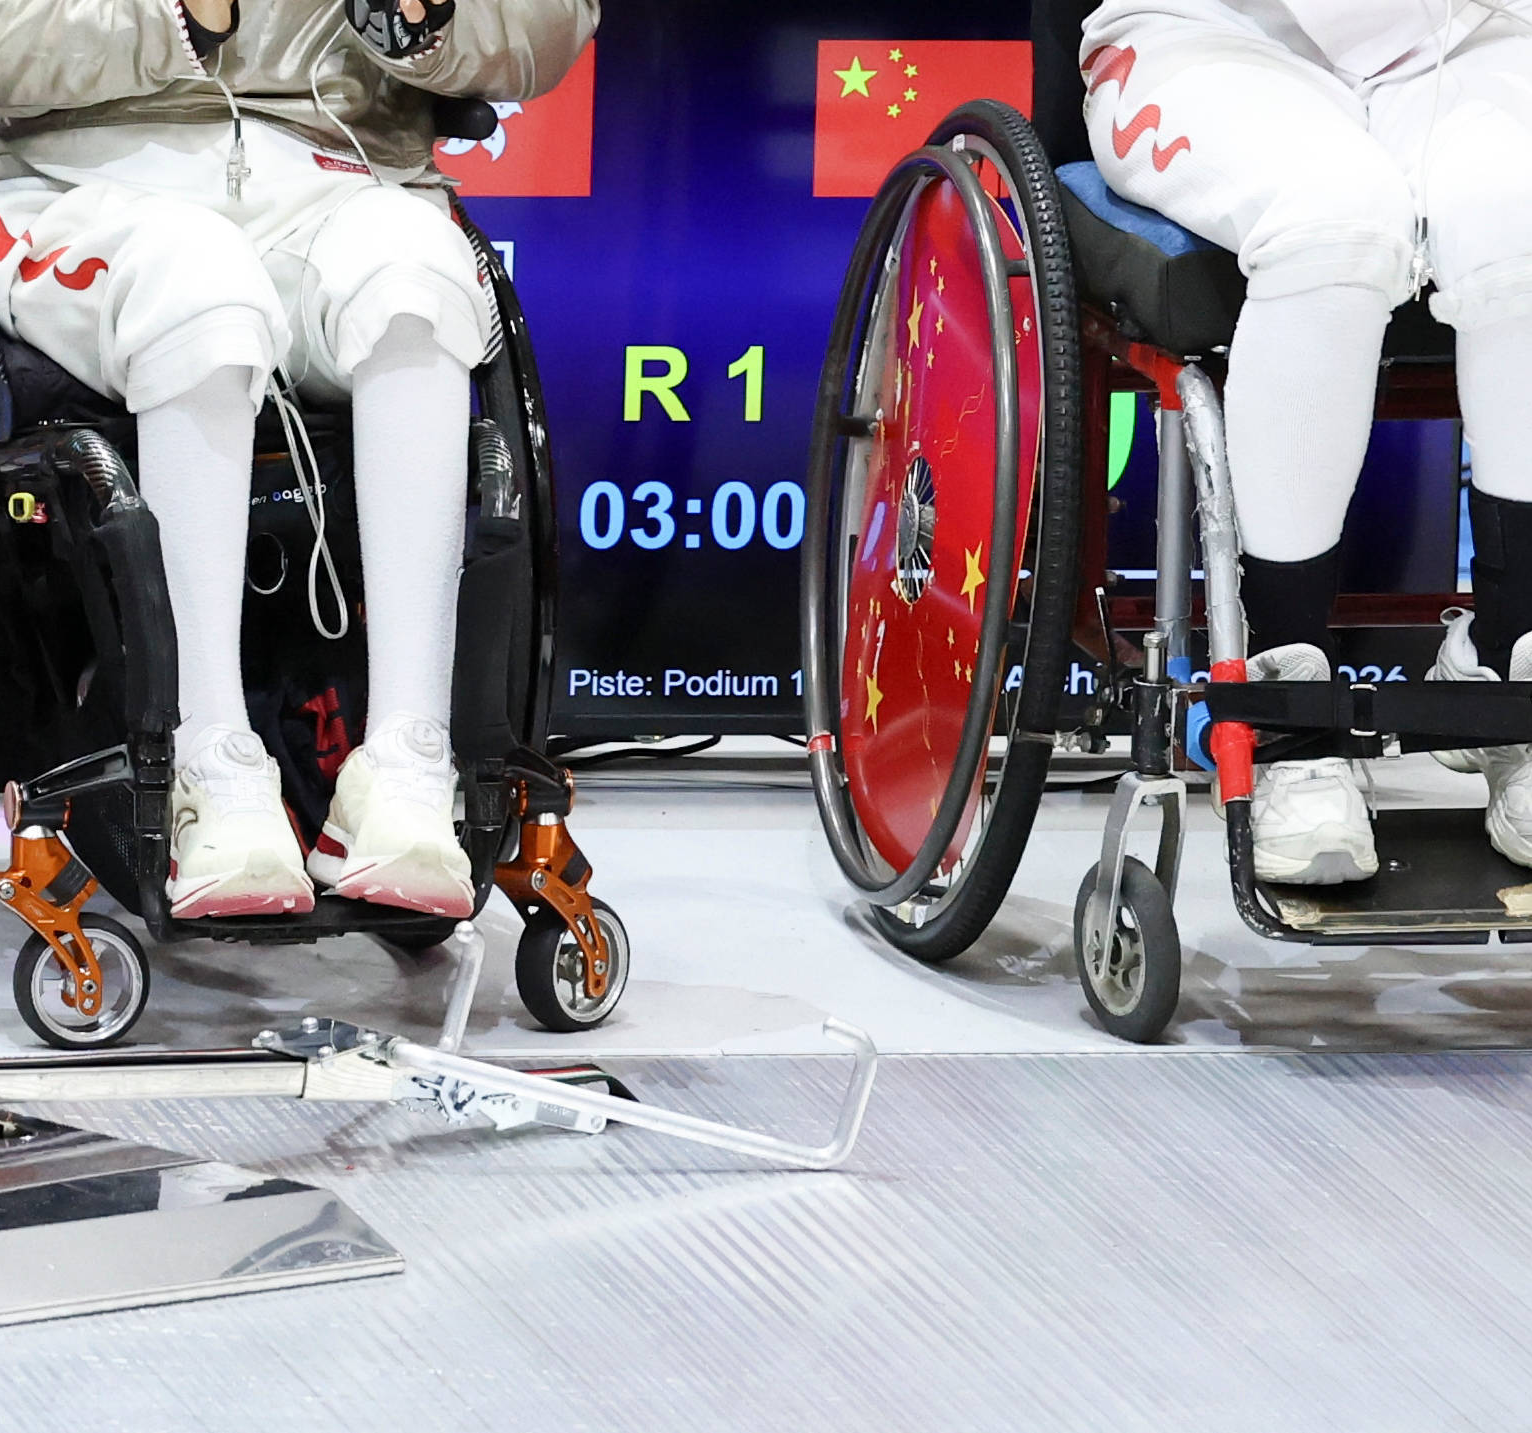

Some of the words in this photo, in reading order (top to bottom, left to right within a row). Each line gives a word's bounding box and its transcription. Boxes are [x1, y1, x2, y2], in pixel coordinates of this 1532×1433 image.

[623, 346, 691, 422] R
[728, 346, 764, 422] 1
[579, 481, 806, 550] 03:00
[569, 669, 653, 696] Piste:
[664, 669, 778, 696] Podium
